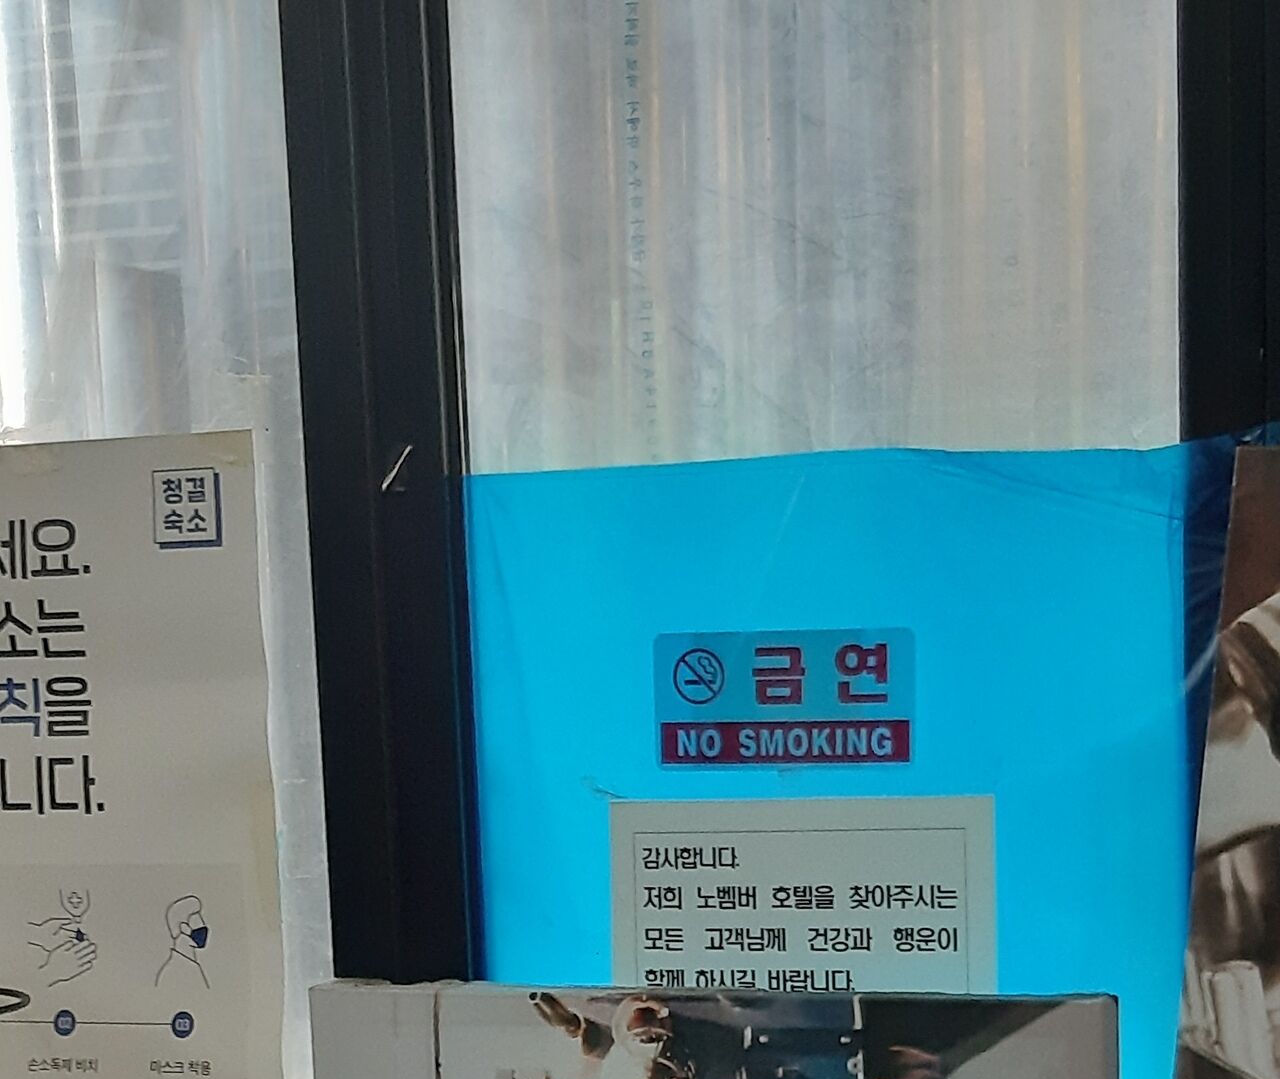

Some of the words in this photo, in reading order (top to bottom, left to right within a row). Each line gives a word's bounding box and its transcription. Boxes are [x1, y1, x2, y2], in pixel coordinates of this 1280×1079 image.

[161, 476, 207, 505] 청결
[163, 508, 208, 534] 숙소
[675, 729, 722, 758] NO
[738, 726, 894, 758] SMOKING
[641, 846, 740, 870] 감사합니다.
[642, 885, 684, 910] 저희
[696, 884, 758, 911] 노벰버
[771, 885, 835, 910] 호텔을
[848, 883, 959, 911] 찾아주시는
[643, 928, 685, 952] 모든
[703, 927, 787, 952] 고객님께
[807, 927, 873, 953] 건강과
[893, 926, 959, 953] 행운이
[767, 969, 856, 993] 바랍니다.
